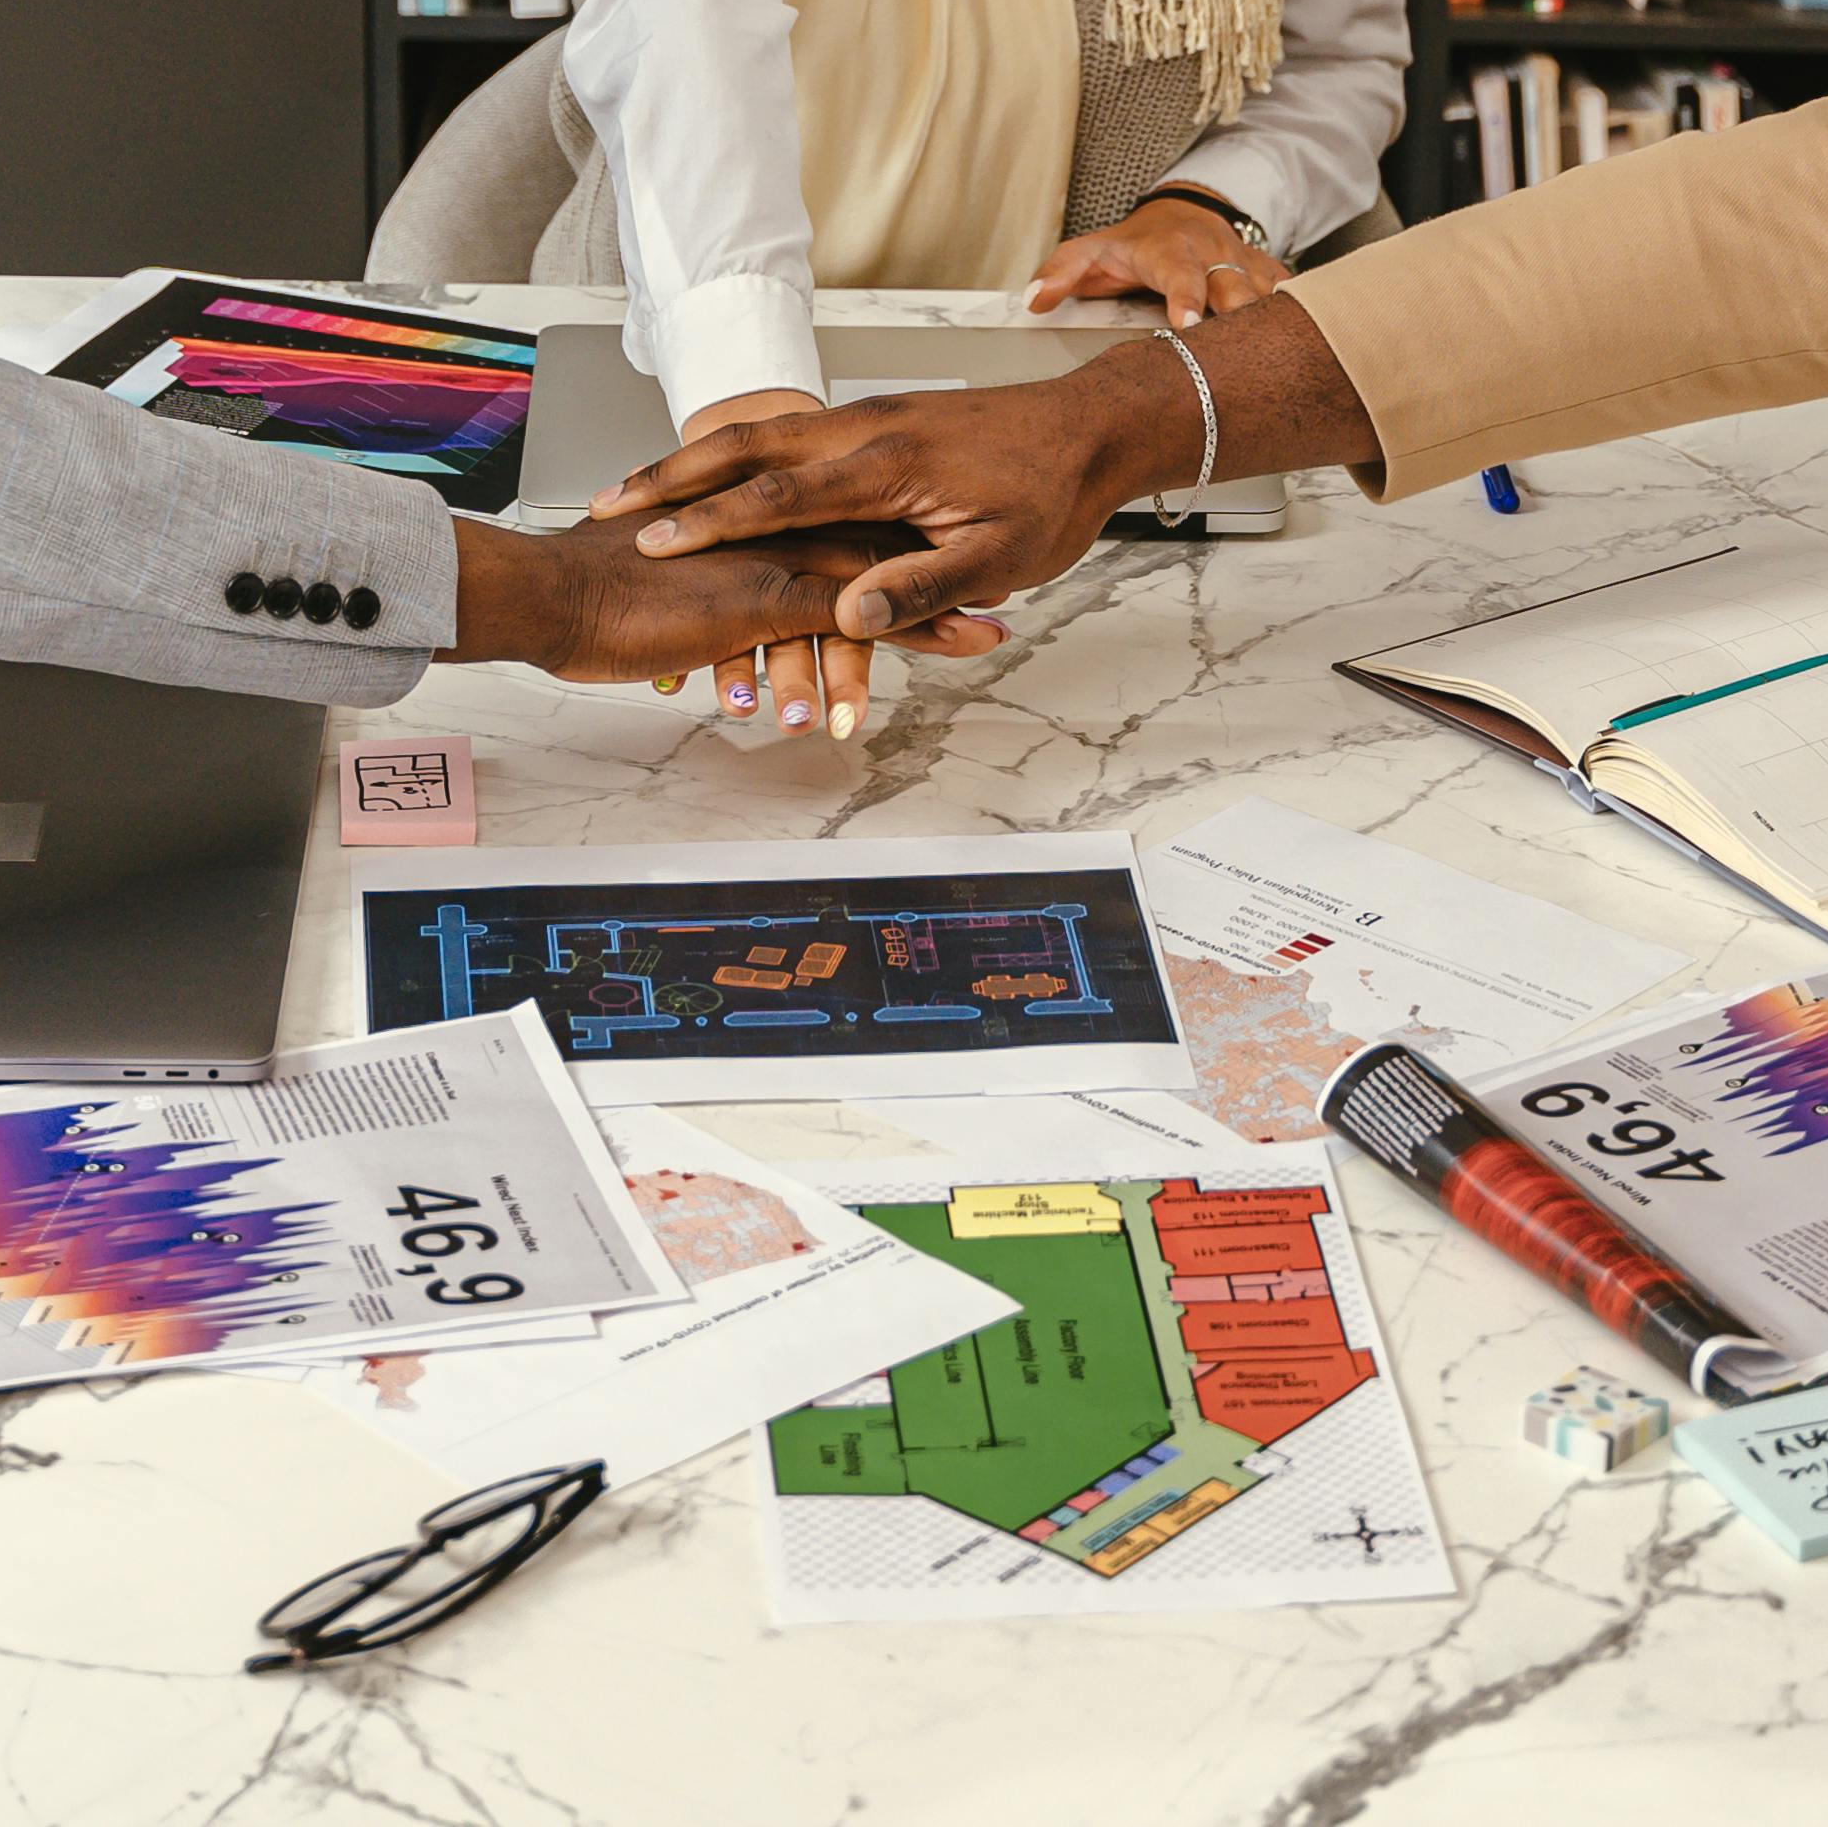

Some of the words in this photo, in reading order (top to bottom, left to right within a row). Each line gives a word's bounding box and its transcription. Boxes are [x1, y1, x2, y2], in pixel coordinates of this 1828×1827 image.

[1171, 845, 1223, 869] Program
[1223, 864, 1261, 884] Policy
[1263, 877, 1344, 915] Metropolitan
[1355, 911, 1383, 927] B
[1183, 933, 1229, 955] COVID-19
[1231, 953, 1280, 975] Confirmed
[1110, 1108, 1165, 1134] confirmed
[1521, 1082, 1726, 1182] 46,9
[1546, 1139, 1581, 1162] Index
[1581, 1160, 1612, 1181] Next
[490, 1173, 514, 1202] Wired
[1254, 1192, 1312, 1203] Robotics
[1613, 1179, 1653, 1206] Wired
[1014, 1199, 1050, 1209] Shop
[1164, 1194, 1237, 1206] Electronics
[506, 1202, 528, 1225] Next
[972, 1209, 1027, 1218] Machine
[1030, 1206, 1095, 1217] Technical
[1219, 1208, 1290, 1218] Classroom
[386, 1184, 525, 1305] 46,9
[516, 1220, 540, 1254] Index
[846, 1240, 895, 1266] Counties
[1193, 1248, 1215, 1258] 111
[1219, 1243, 1291, 1256] Classroom
[829, 1262, 845, 1273] by
[786, 1271, 828, 1291] number
[712, 1294, 769, 1322] confirmed
[656, 1320, 712, 1348] COVID-19
[1237, 1318, 1310, 1329] Classroom
[1014, 1319, 1037, 1362] Assembly
[1060, 1319, 1080, 1354] Factory
[619, 1345, 654, 1362] cases
[944, 1363, 964, 1384] Line
[1022, 1364, 1041, 1384] Line
[1069, 1356, 1085, 1380] Floor
[1235, 1371, 1297, 1383] Learning
[1220, 1380, 1279, 1391] Distance
[1282, 1378, 1318, 1391] Long
[1251, 1395, 1324, 1406] Classroom
[820, 1444, 838, 1465] Line
[842, 1432, 861, 1476] Finishing
